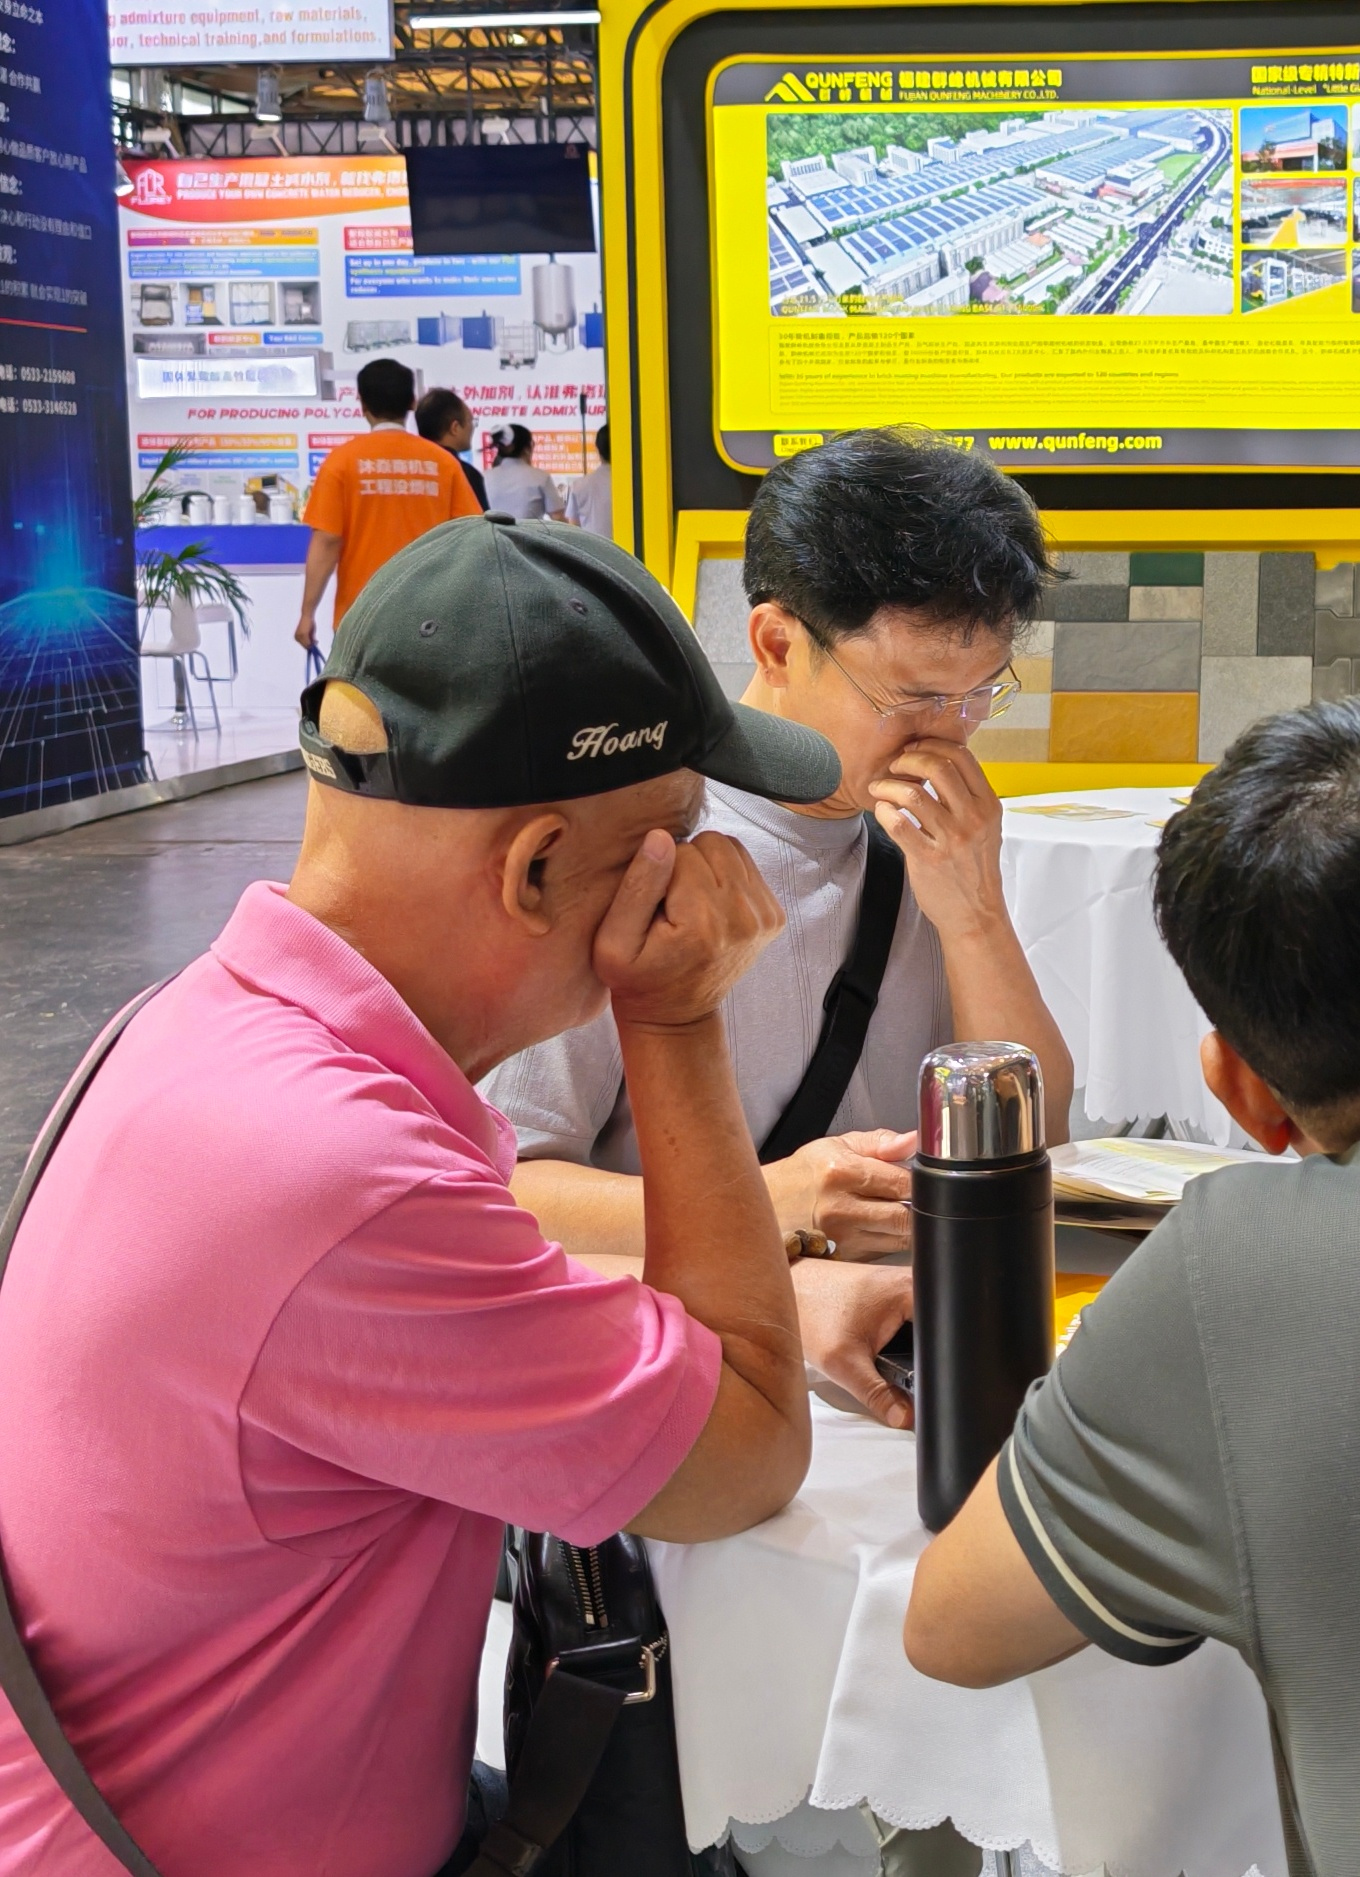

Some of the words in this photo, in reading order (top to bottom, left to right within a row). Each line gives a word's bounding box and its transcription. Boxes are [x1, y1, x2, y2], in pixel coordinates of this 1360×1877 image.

[120, 11, 186, 25] admixture
[190, 8, 265, 26] equipment,
[269, 9, 293, 22] raw
[299, 6, 368, 23] materials,
[139, 32, 200, 47] technical
[292, 28, 382, 45] formulations.
[806, 71, 893, 88] QUNFENG
[929, 91, 971, 101] QUNFENG
[187, 408, 217, 420] FOR
[220, 407, 300, 420] PRODUCING
[304, 406, 365, 419] POLYCA
[470, 404, 528, 417] NCRETE
[532, 404, 606, 417] ADMIXUR
[989, 433, 1162, 453] www.qunfeng.com
[566, 720, 669, 761] Hoang
